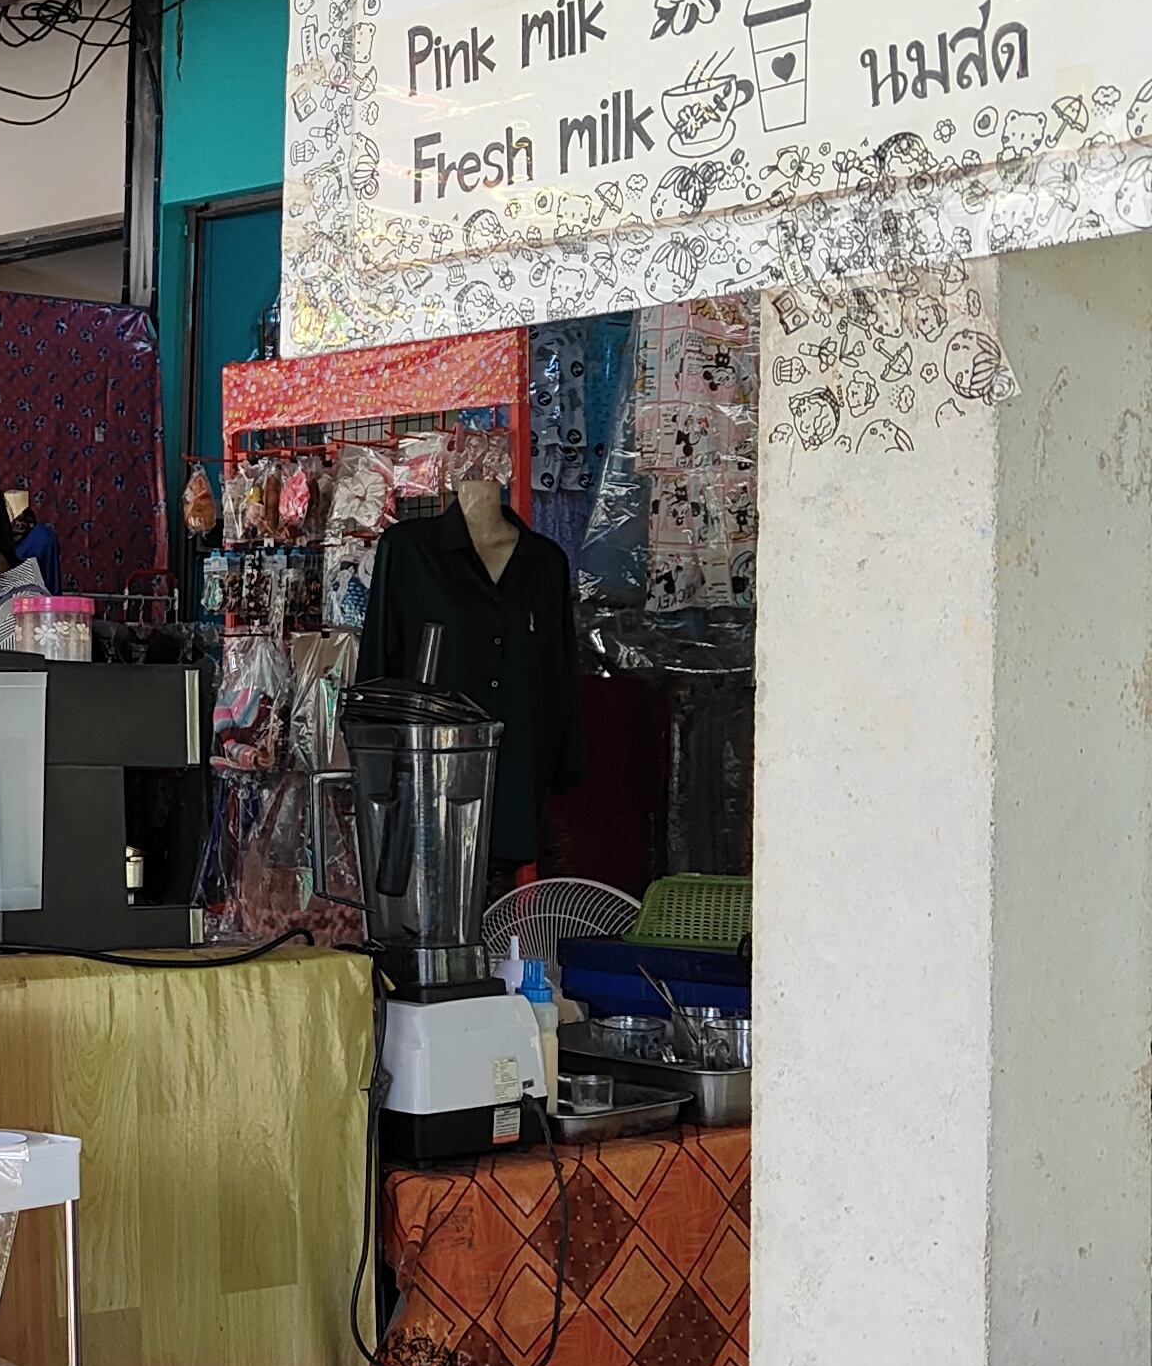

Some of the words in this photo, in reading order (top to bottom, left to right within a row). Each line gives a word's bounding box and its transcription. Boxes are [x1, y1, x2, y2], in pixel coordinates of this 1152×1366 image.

[408, 25, 496, 96] Pink
[860, 0, 1029, 107] นมสด
[413, 127, 533, 204] Fresh
[560, 89, 659, 173] milk
